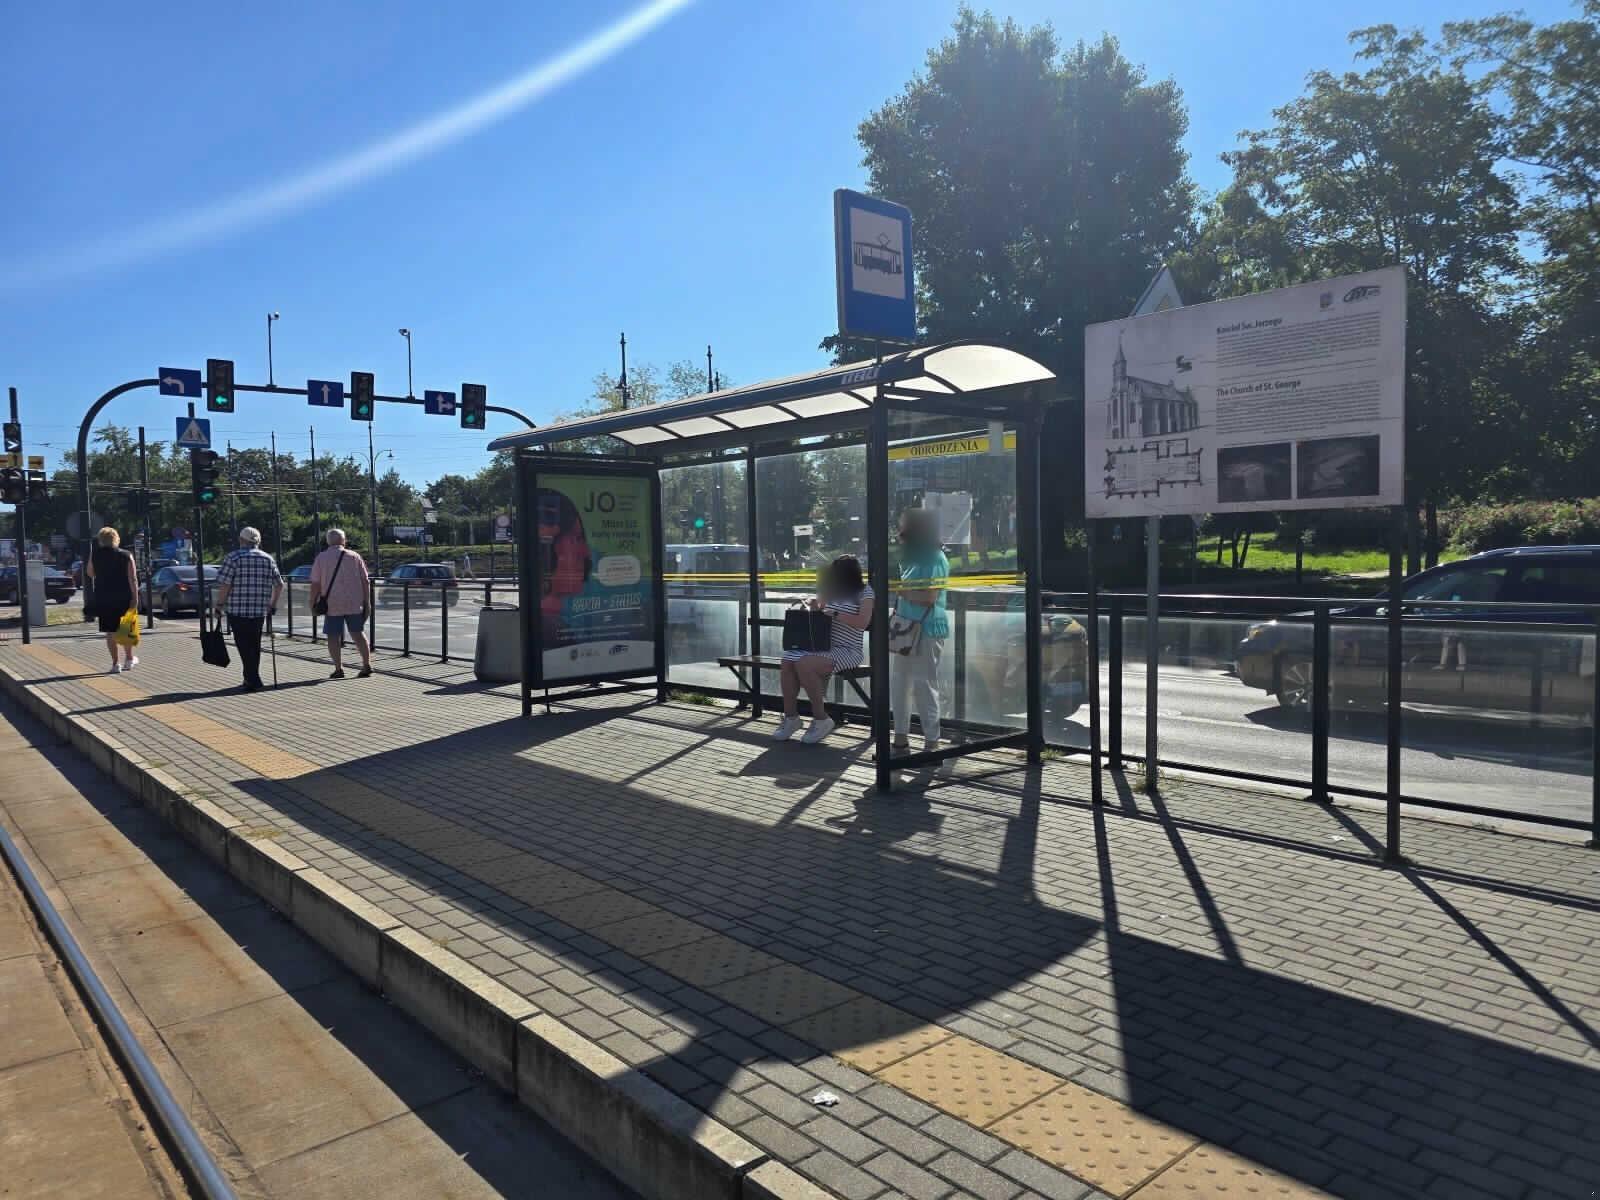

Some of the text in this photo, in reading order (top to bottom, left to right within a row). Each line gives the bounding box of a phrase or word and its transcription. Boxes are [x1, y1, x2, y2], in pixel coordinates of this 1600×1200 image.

[1216, 387, 1228, 397] The
[1230, 383, 1253, 395] Church
[1255, 382, 1262, 393] of
[1275, 380, 1301, 394] George
[911, 439, 979, 456] ODRODZENIA
[584, 491, 615, 513] JO
